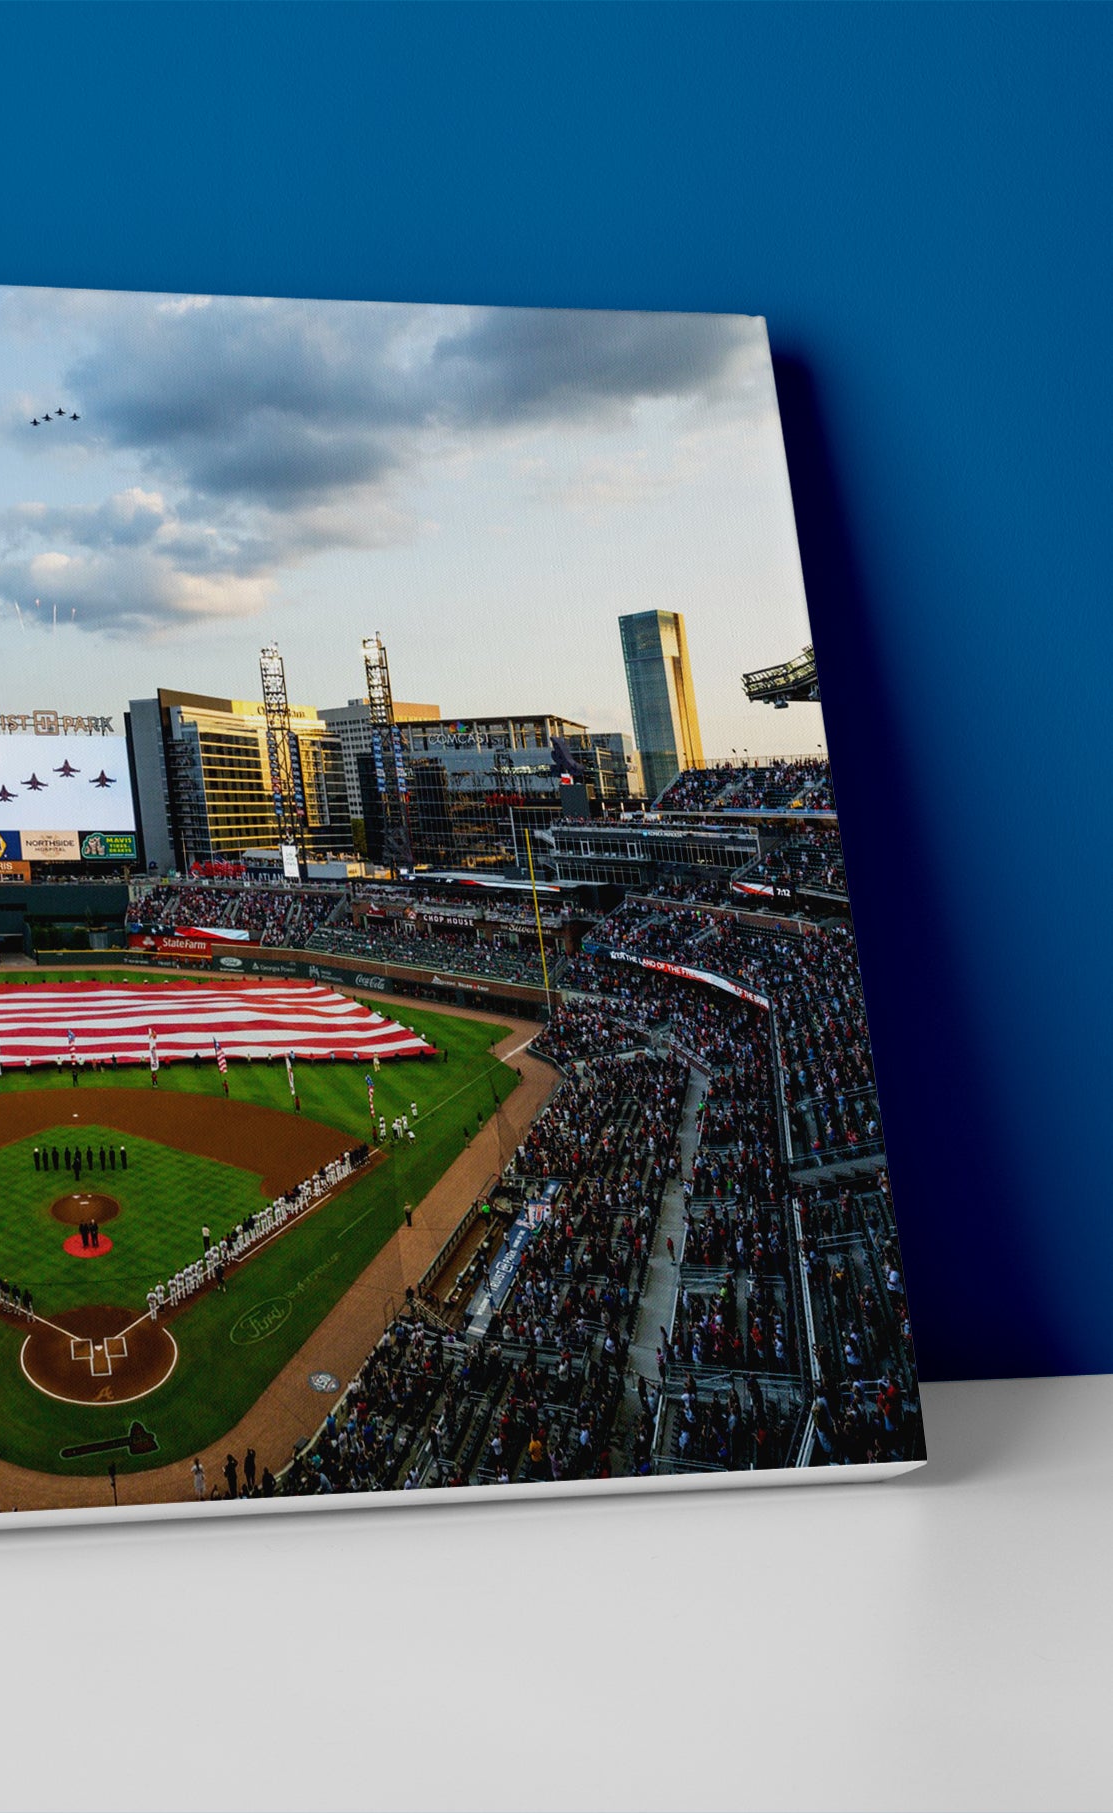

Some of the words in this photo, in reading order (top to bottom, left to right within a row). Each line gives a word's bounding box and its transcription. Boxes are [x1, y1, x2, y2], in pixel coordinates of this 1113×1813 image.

[63, 715, 114, 732] PARK
[428, 732, 489, 745] COMCAST
[25, 840, 75, 848] NORTHSIDE
[776, 888, 791, 897] 7:12
[423, 914, 444, 923] CHOP
[446, 917, 474, 926] HOUSE
[638, 957, 656, 968] LAND
[667, 964, 681, 974] THE
